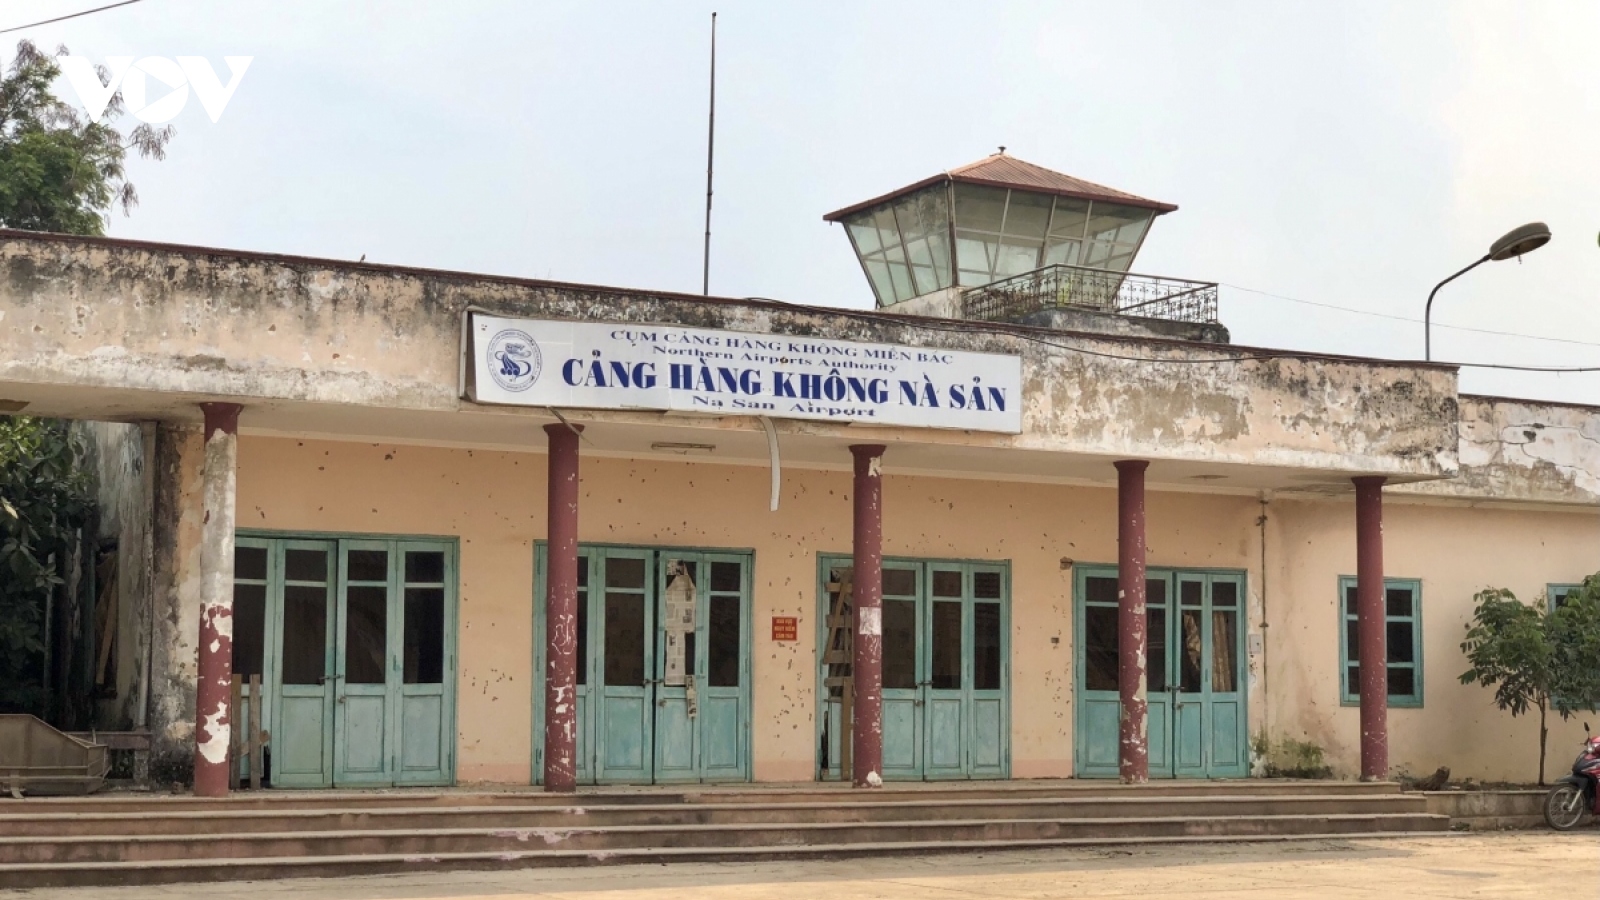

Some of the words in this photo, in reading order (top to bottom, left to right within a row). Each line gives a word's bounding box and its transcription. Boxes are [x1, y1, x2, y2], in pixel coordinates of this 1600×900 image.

[611, 330, 657, 347] CỤM
[664, 331, 720, 347] CẢNG
[726, 336, 781, 351] HÀNG
[788, 342, 858, 357] KHÔNG
[652, 346, 734, 360] Northern
[740, 353, 813, 365] Airports
[818, 358, 898, 373] Authority
[562, 349, 657, 389] CẢNG
[669, 357, 762, 395] HÀNG
[772, 368, 889, 404] KHÔNG
[898, 372, 940, 407] NÀ
[949, 376, 1007, 412] SẢN
[731, 398, 775, 410] San
[789, 402, 876, 417] Airport
